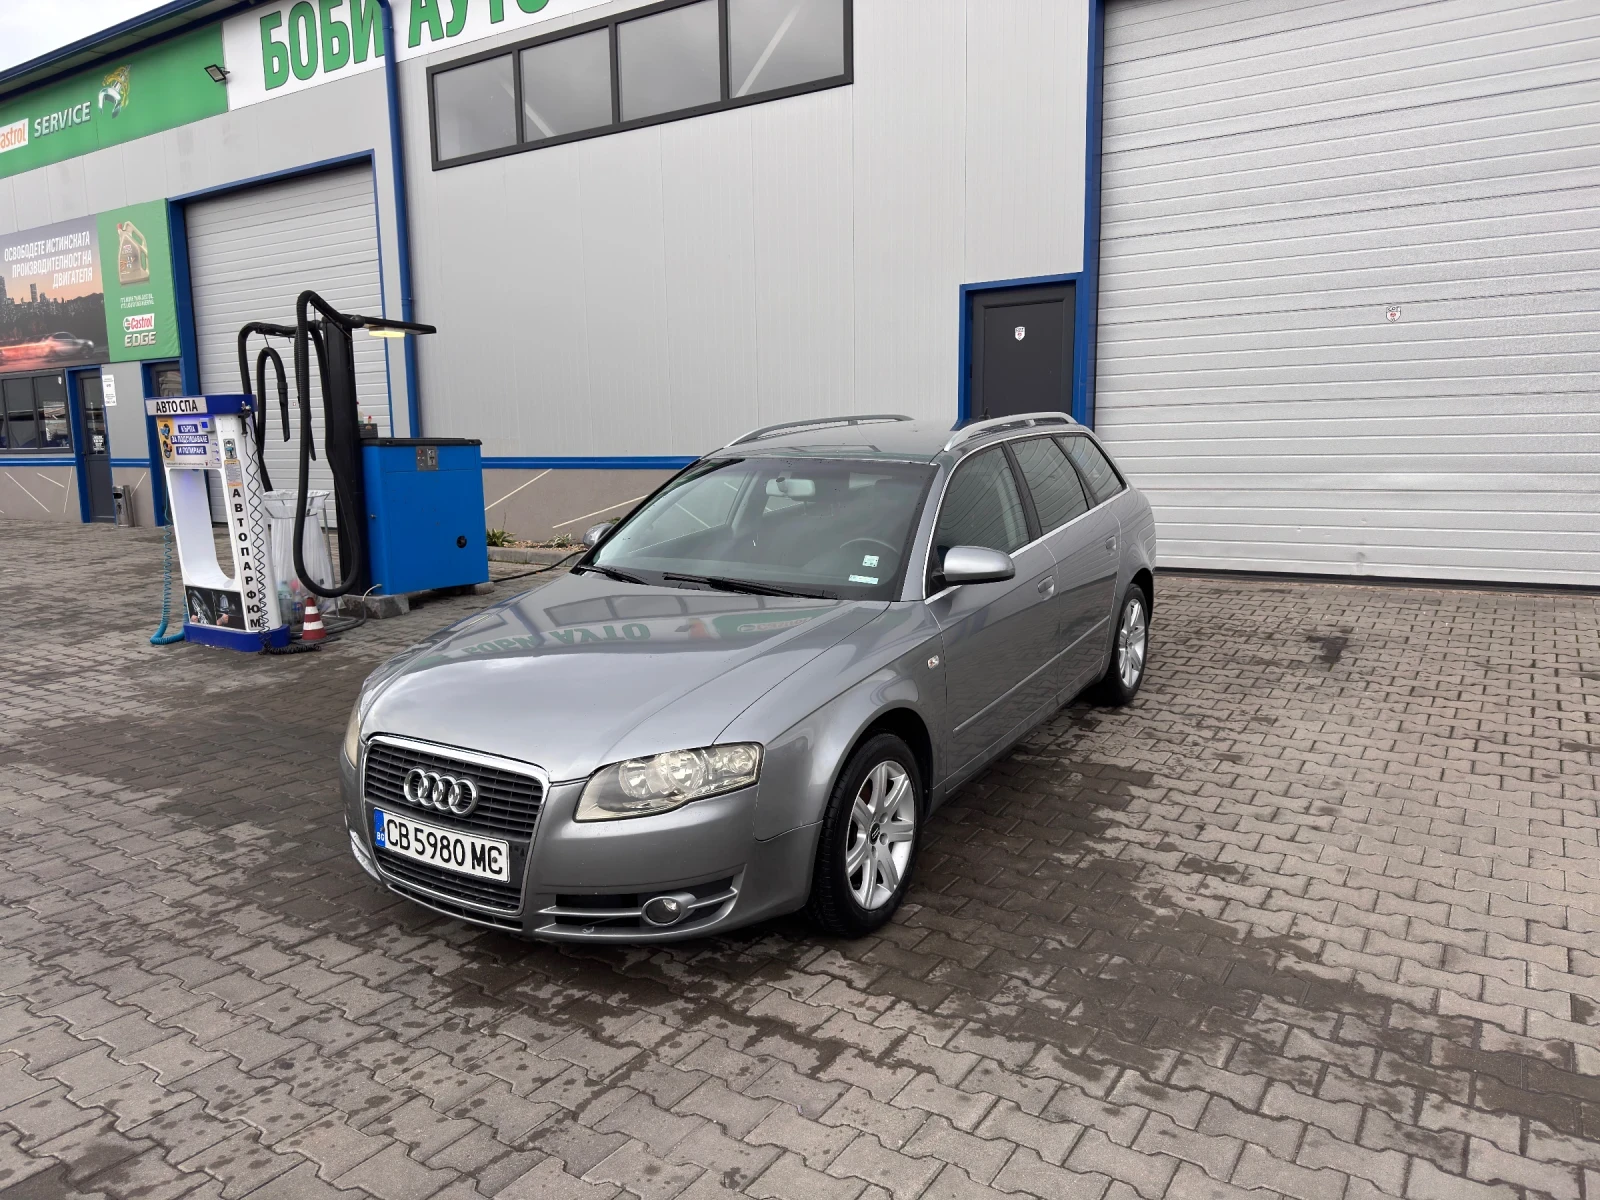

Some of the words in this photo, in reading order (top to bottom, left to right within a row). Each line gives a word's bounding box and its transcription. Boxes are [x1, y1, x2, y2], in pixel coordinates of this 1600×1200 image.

[260, 0, 385, 91] БОБИ
[0, 122, 27, 150] astrol
[34, 101, 91, 138] SERVICE
[4, 240, 46, 262] ОСВОБОДЕТЕ
[46, 231, 91, 254] ИСТИНСКАТА
[12, 251, 82, 278] ПРОИЗВОДИТЕЛНОСТ
[82, 249, 92, 265] НА
[52, 266, 93, 290] ДВИГАТЕЛЯ
[130, 315, 153, 330] Castrol
[124, 331, 157, 348] EDGE
[156, 400, 178, 413] АВТО
[179, 399, 198, 412] СПА
[376, 831, 385, 841] BG
[414, 829, 466, 867] 5980
